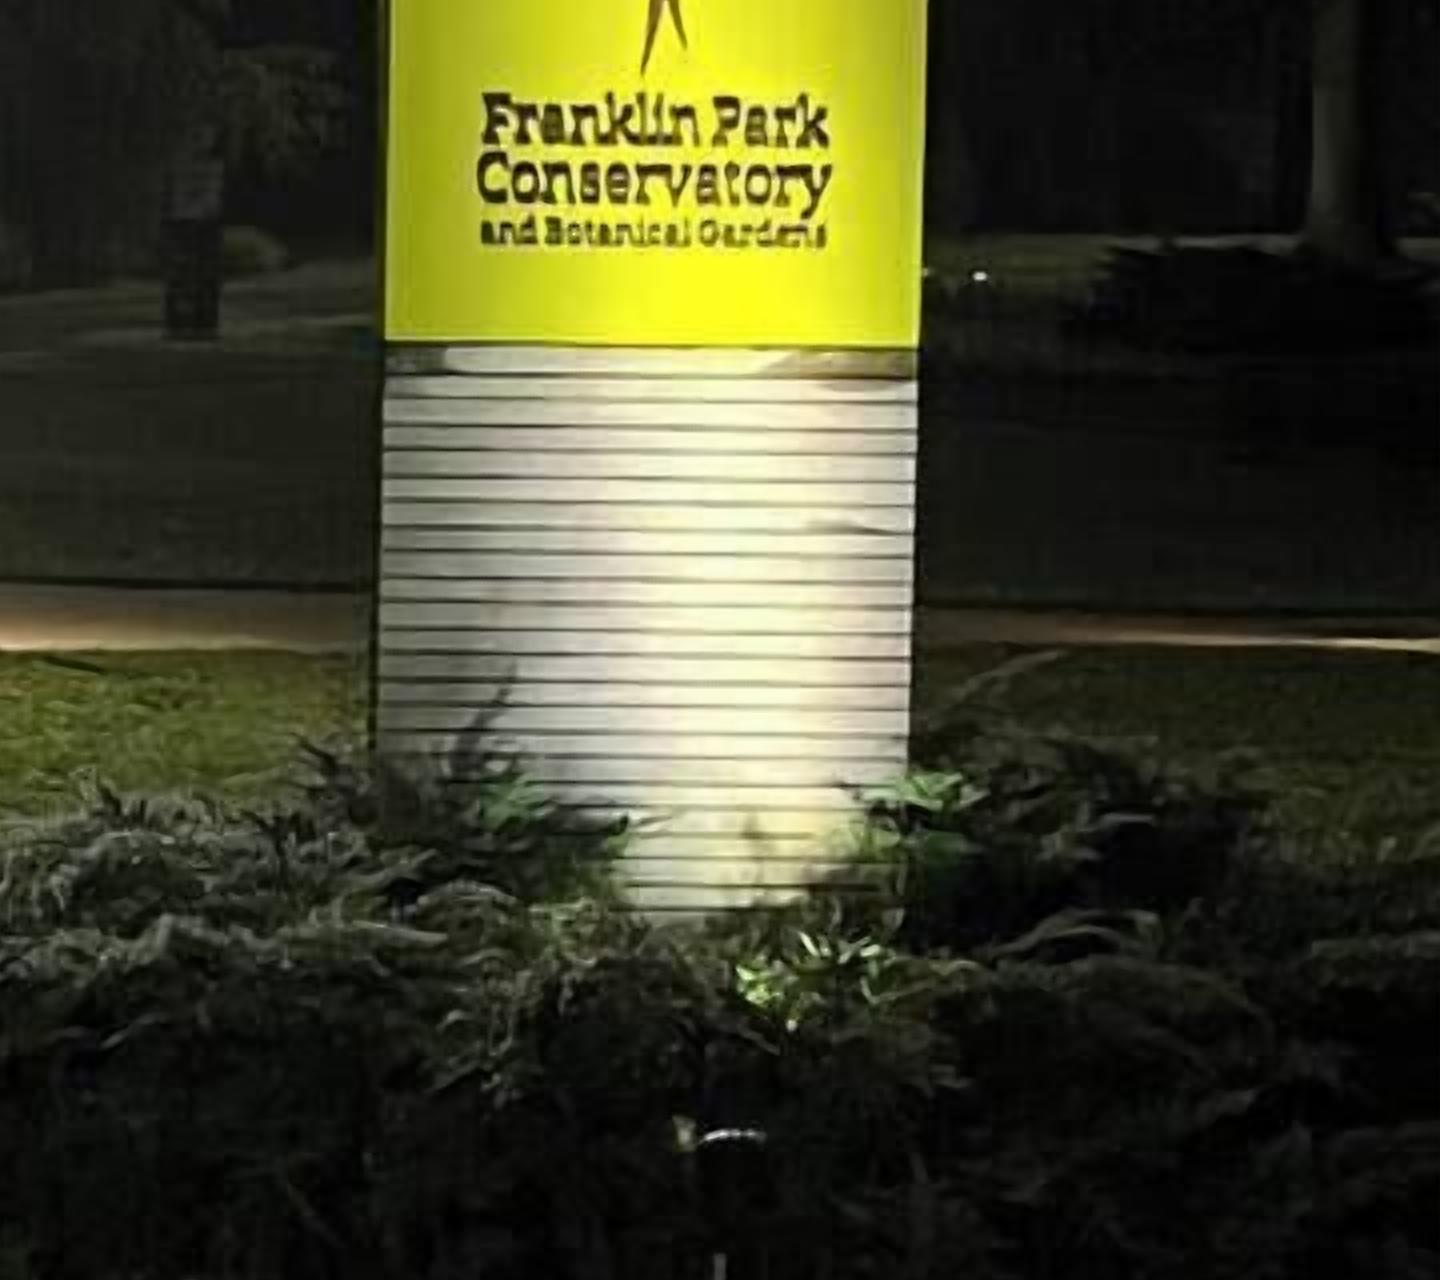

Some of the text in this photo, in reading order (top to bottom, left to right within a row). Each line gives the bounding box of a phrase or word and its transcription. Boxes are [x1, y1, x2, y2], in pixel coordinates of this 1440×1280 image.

[481, 92, 830, 148] Franklin Park
[477, 151, 832, 219] Conservatory
[480, 213, 538, 246] and
[544, 215, 691, 248] Botanical
